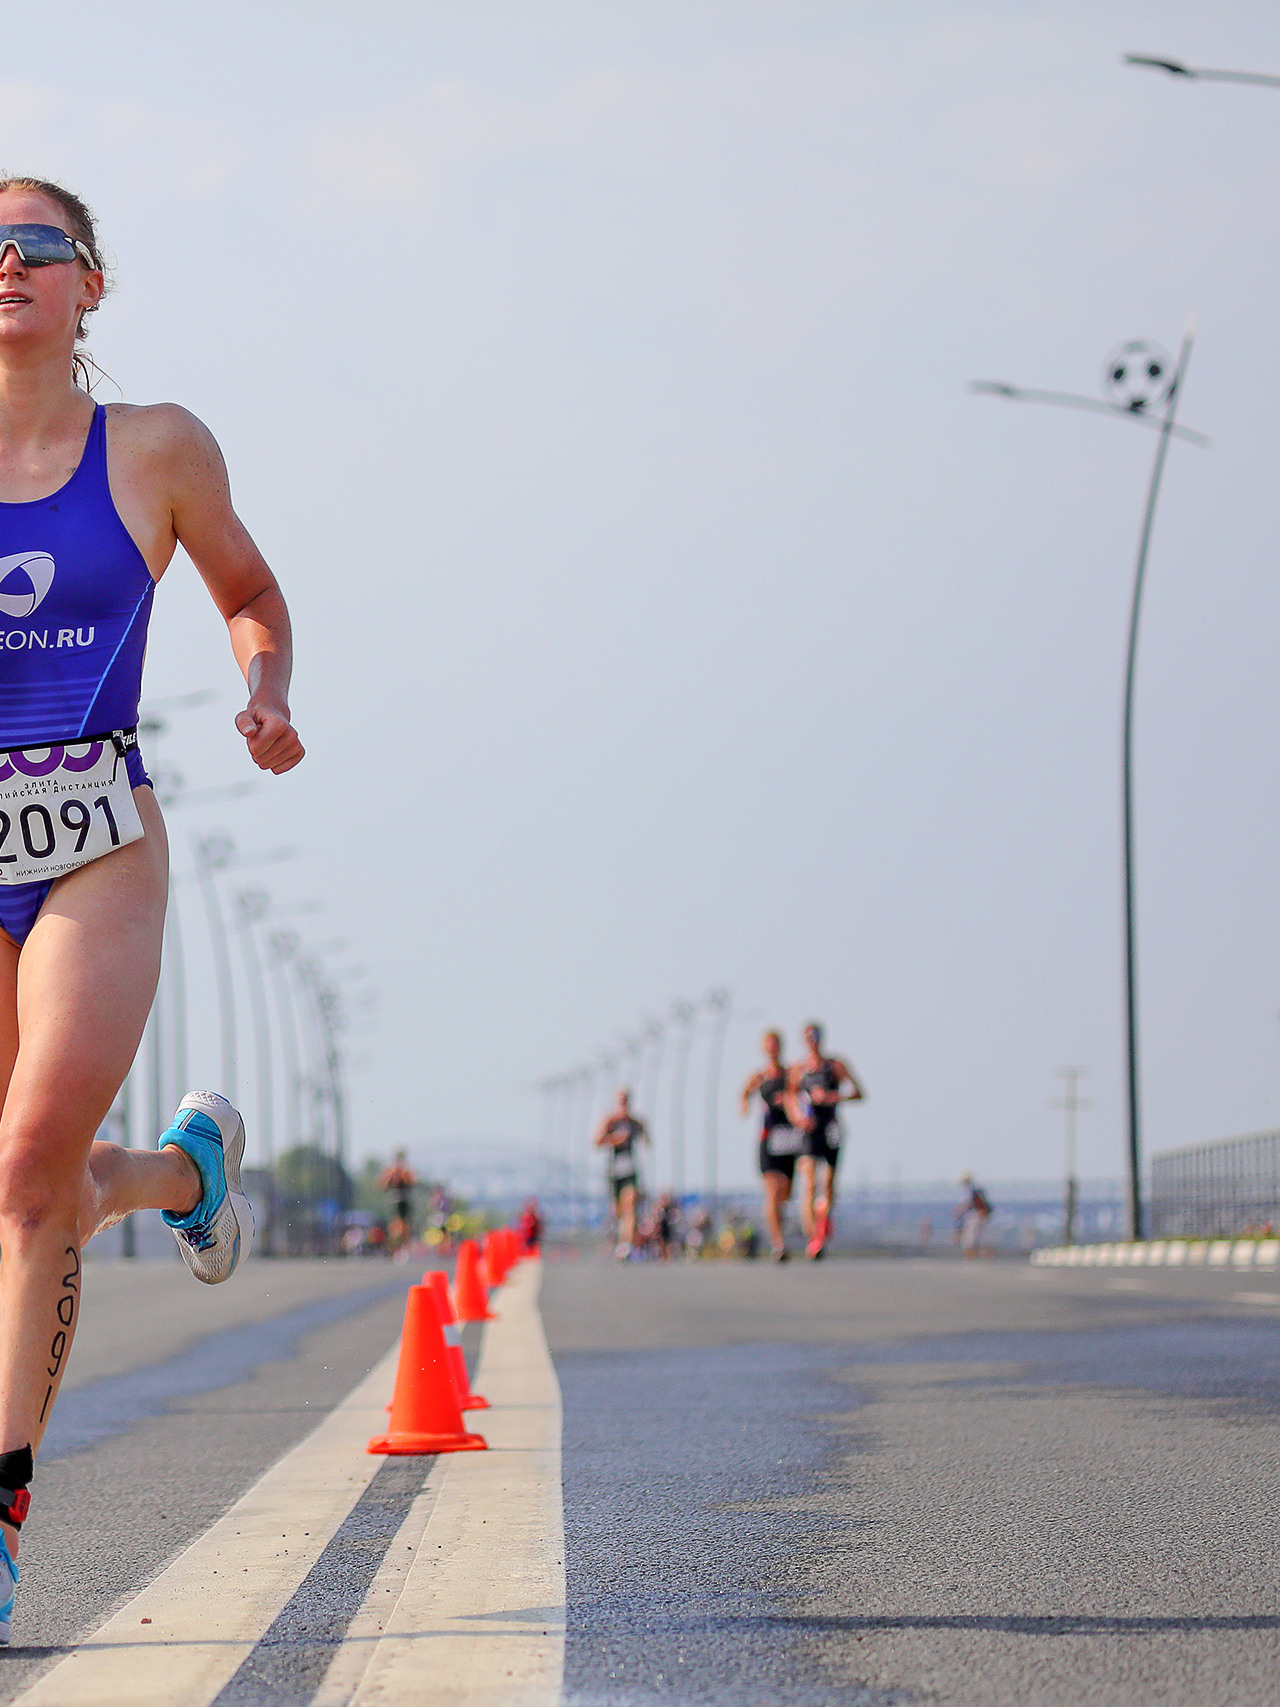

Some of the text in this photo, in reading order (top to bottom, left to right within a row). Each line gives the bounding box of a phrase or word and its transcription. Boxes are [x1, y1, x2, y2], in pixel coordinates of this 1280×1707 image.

[24, 779, 59, 790] ЭЛИТА
[53, 779, 113, 794] ДИСТАНЦИЯ
[15, 865, 49, 877] НИЖНИЙ
[39, 1246, 79, 1423] 2091
